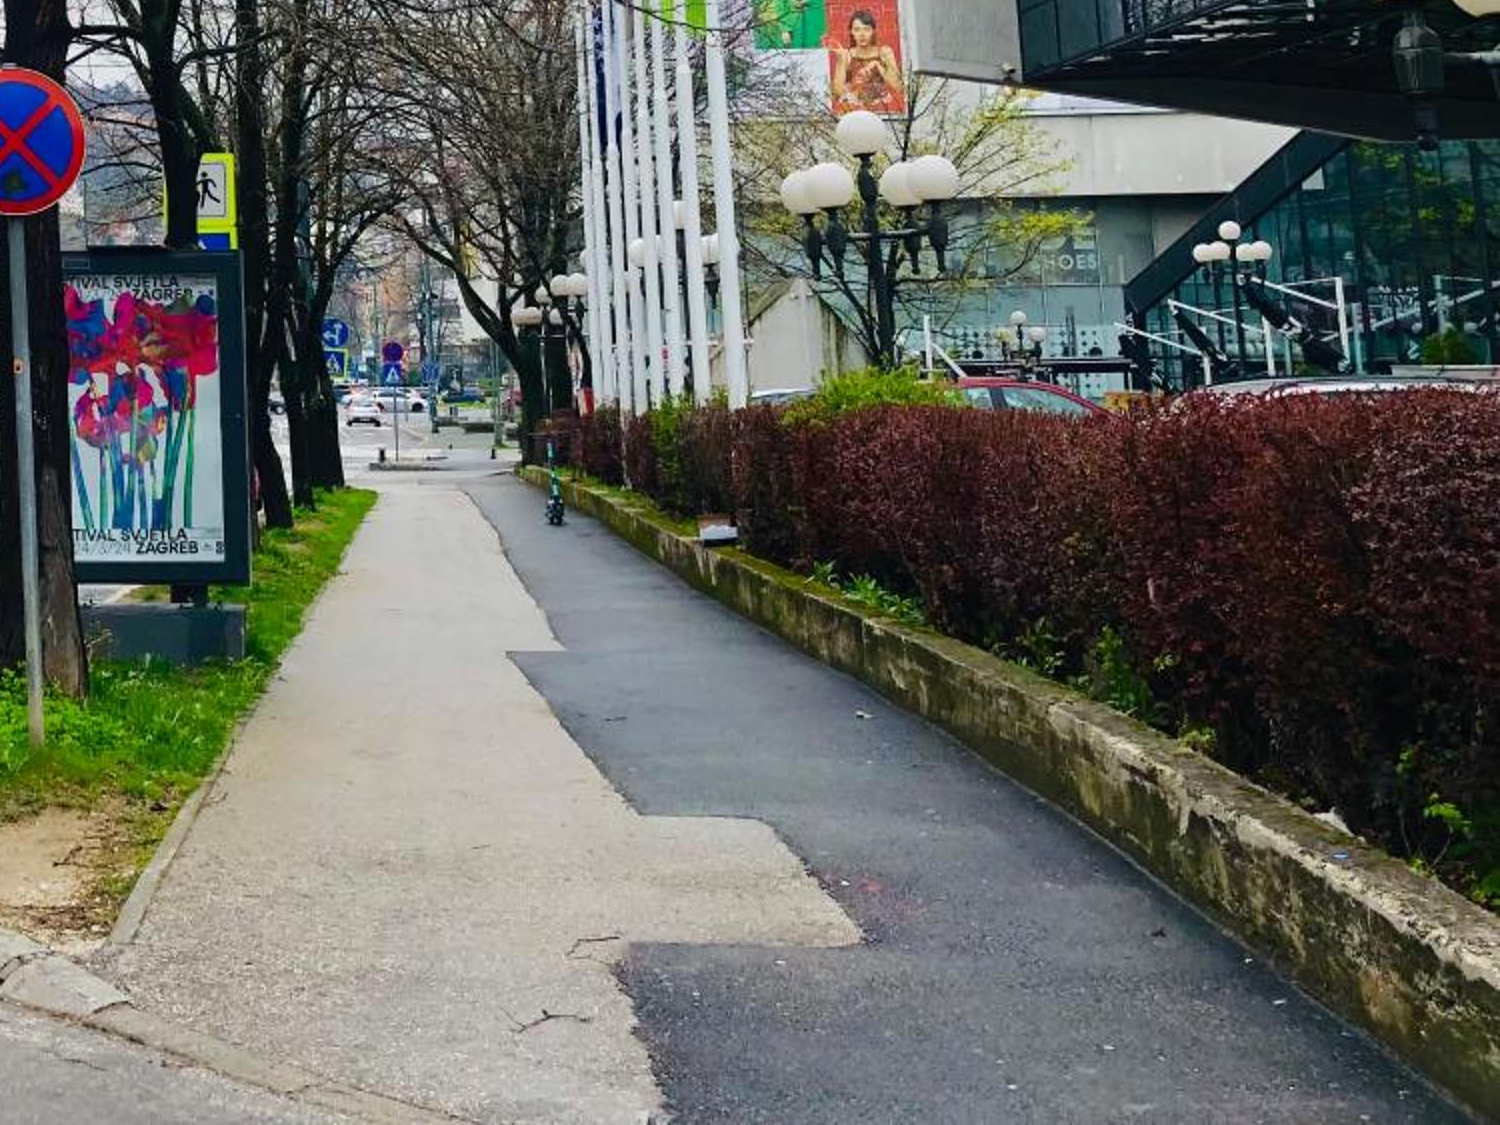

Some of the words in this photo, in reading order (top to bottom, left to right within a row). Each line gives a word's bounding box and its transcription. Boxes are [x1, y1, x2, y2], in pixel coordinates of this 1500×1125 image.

[114, 276, 179, 289] SVJETLA
[74, 528, 117, 542] TIVAL
[121, 528, 188, 542] SVJETLA
[136, 541, 199, 554] ZAGREB
